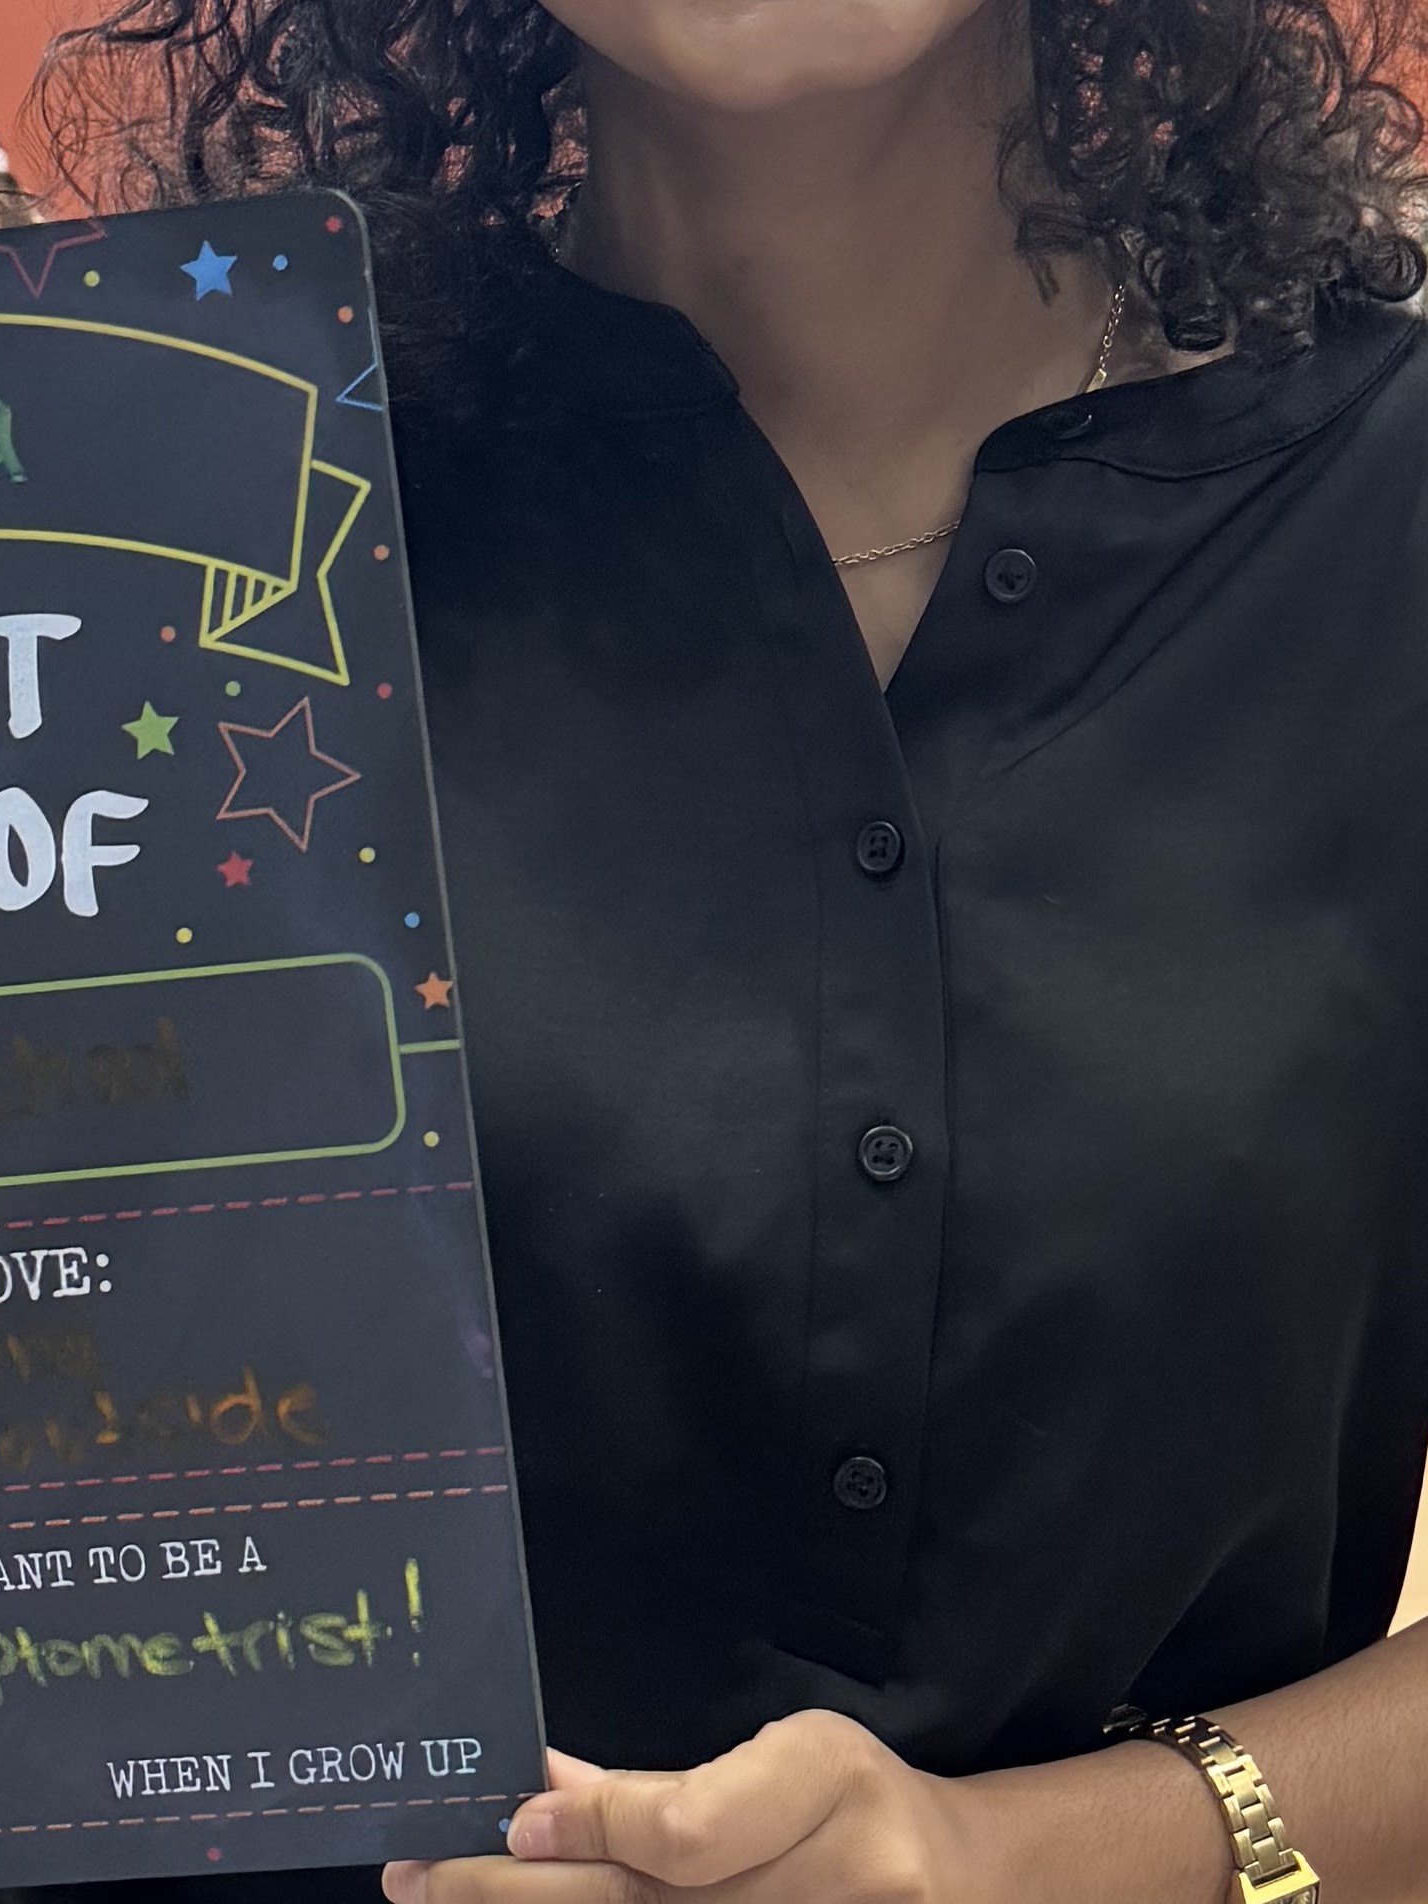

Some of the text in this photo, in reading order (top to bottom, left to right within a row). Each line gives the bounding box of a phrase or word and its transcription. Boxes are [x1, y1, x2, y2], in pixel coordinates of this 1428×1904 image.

[87, 1543, 147, 1585] TO
[159, 1537, 223, 1580] BE
[237, 1535, 269, 1575] A
[105, 1736, 483, 1800] WHEN I GROW UP
